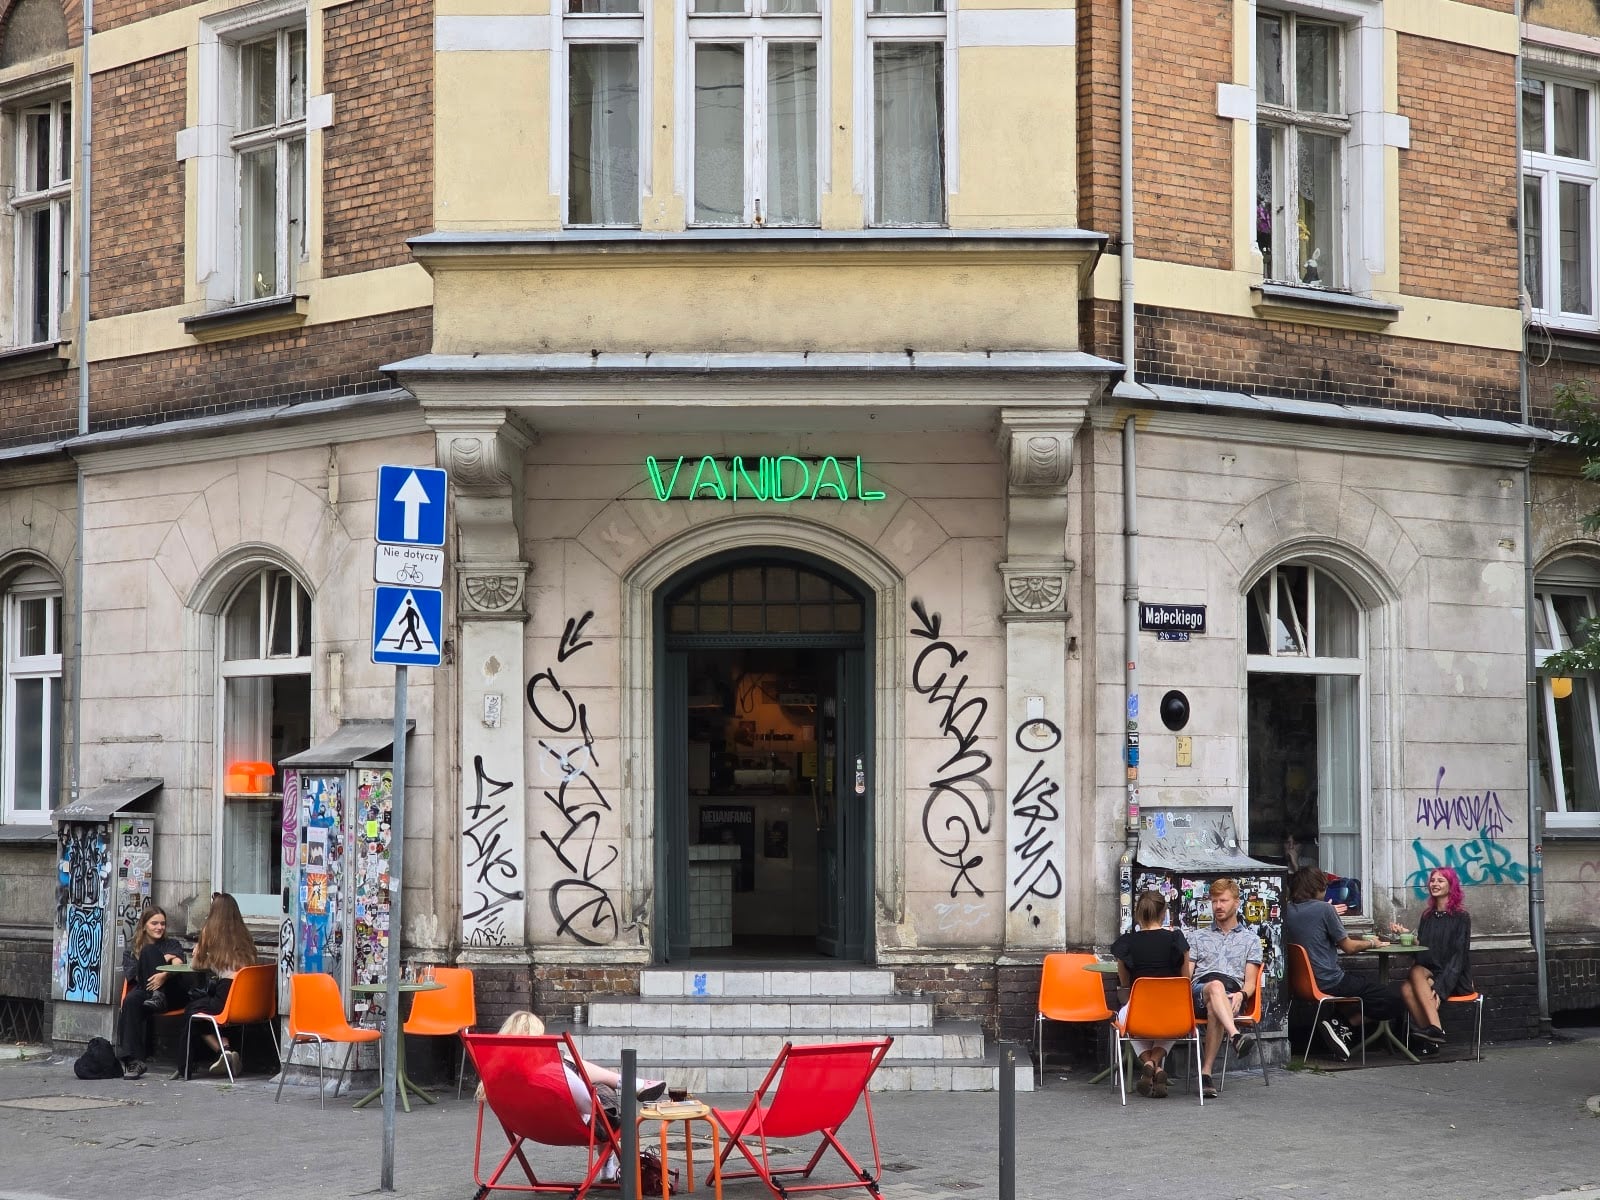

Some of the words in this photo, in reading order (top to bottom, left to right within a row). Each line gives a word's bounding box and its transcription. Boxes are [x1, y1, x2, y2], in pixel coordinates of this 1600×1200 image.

[647, 455, 886, 501] VANDAL
[383, 547, 400, 557] Nie
[403, 549, 439, 563] dotyczy
[1145, 607, 1203, 629] Małeckiego
[1159, 632, 1170, 640] 26
[1178, 632, 1188, 641] 25
[124, 835, 149, 848] B3A
